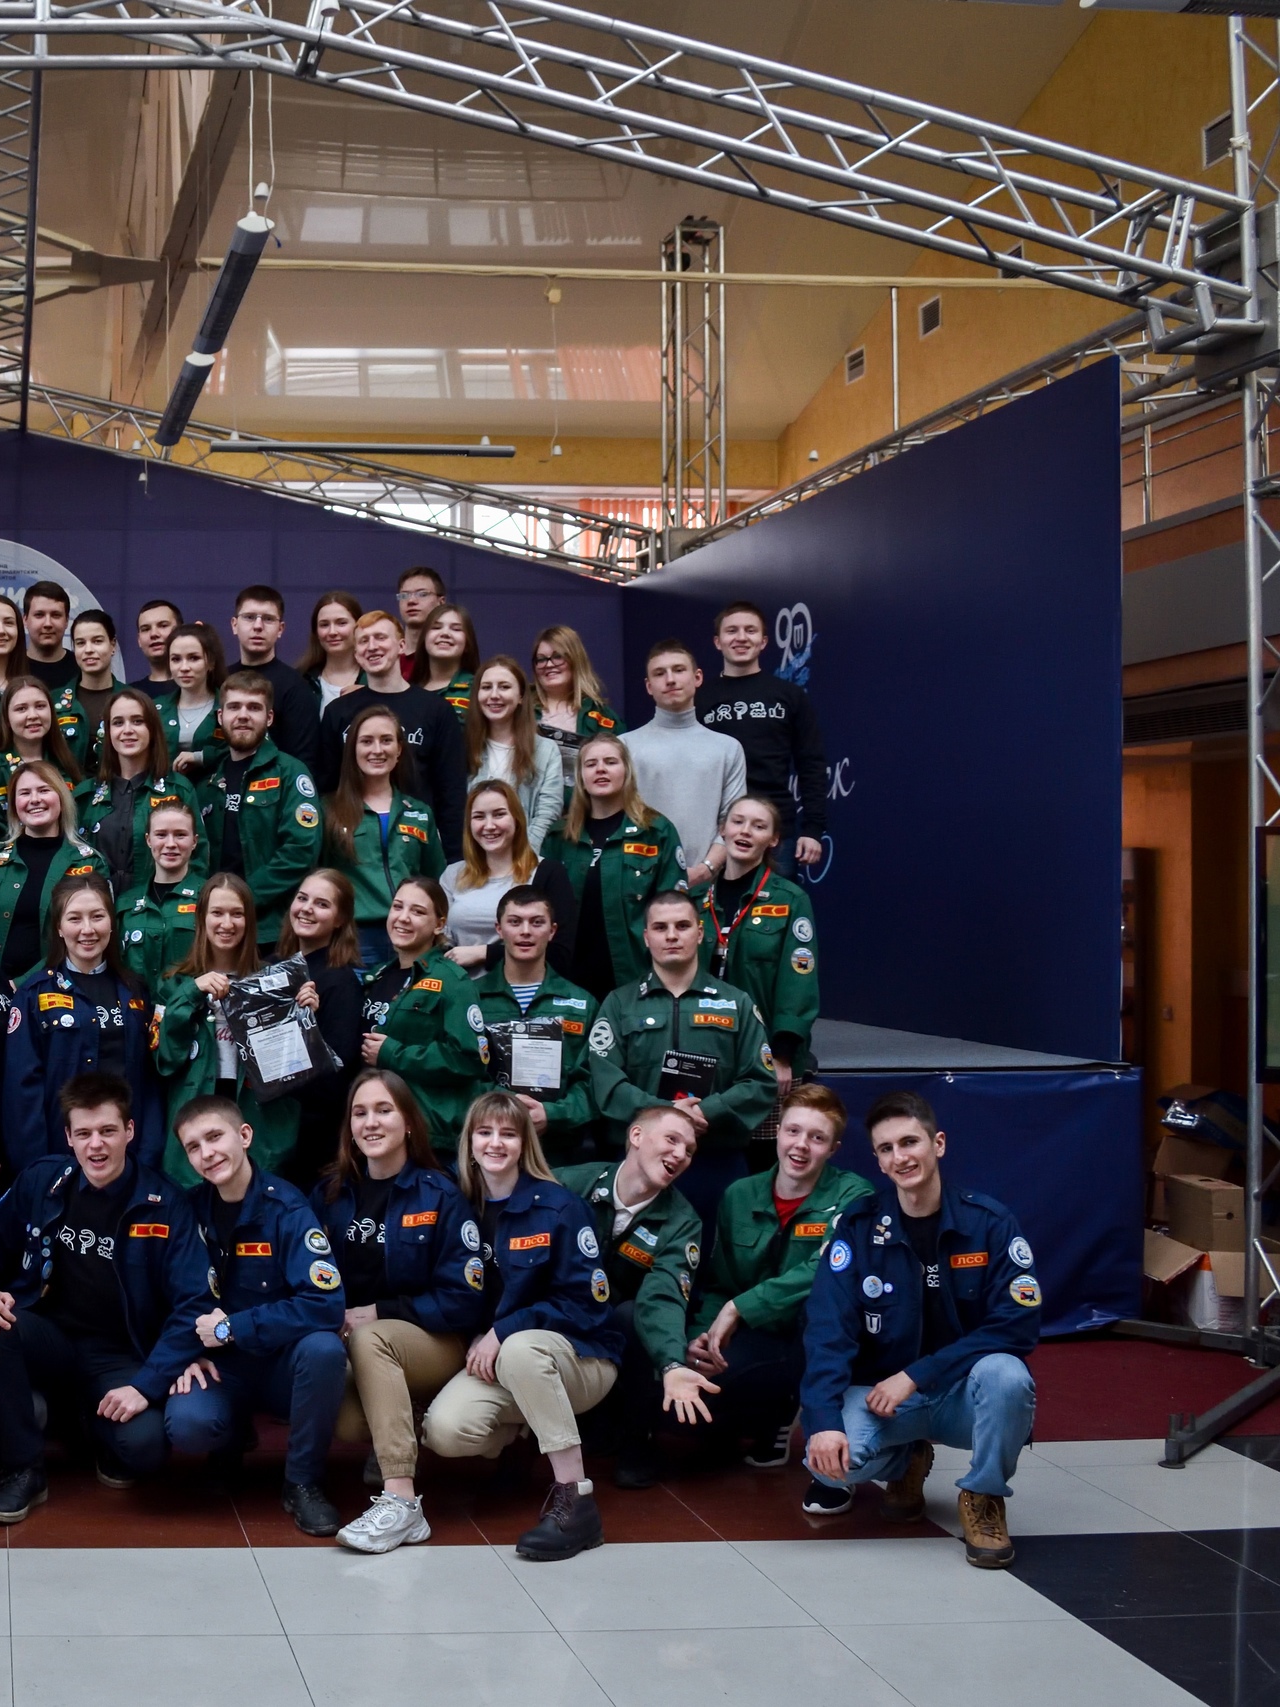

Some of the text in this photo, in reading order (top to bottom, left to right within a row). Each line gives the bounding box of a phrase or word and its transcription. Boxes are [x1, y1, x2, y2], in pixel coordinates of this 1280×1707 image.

[707, 1015, 730, 1025] ЛСО
[415, 1214, 438, 1223] ЛСО
[523, 1236, 545, 1247] ЛСО
[626, 1246, 650, 1262] ЛСО
[956, 1255, 984, 1265] ЛСО
